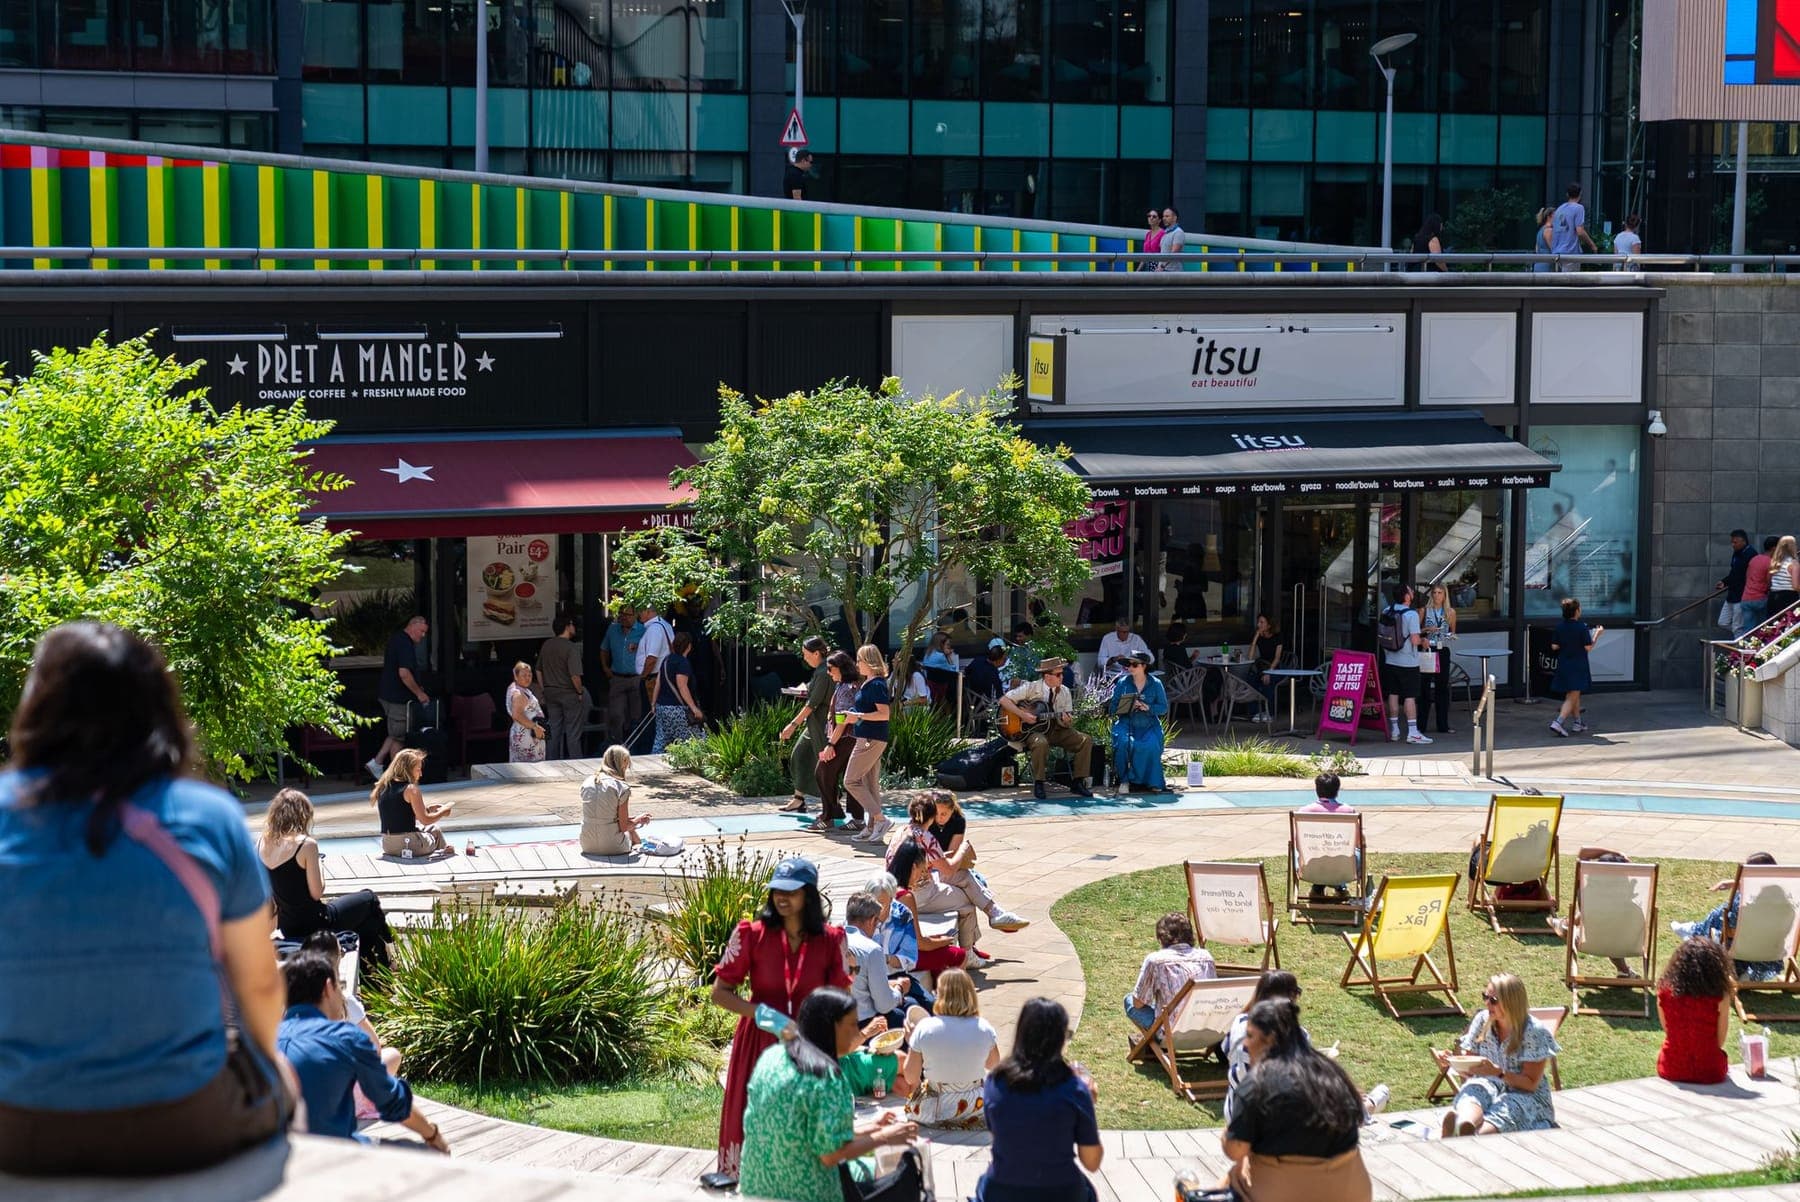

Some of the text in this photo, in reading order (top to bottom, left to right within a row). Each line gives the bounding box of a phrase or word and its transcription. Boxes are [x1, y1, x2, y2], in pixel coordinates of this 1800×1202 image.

[258, 342, 467, 384] PRET A MANGER
[1192, 336, 1261, 376] itsu
[1034, 358, 1050, 374] itsu
[1192, 378, 1258, 388] eat beautiful
[258, 387, 466, 399] ORGANIC COFFEE FRESHLY MADE FOOD
[1231, 434, 1305, 449] itsu
[1183, 485, 1200, 494] sushi
[1216, 485, 1236, 494] soups
[1300, 482, 1322, 492] gyoza
[1438, 478, 1456, 487] sushi
[1469, 478, 1488, 487] soups
[498, 542, 526, 554] Pair
[1080, 533, 1124, 560] ENU
[1337, 663, 1365, 674] TASTE
[1333, 682, 1360, 690] OF ITSU
